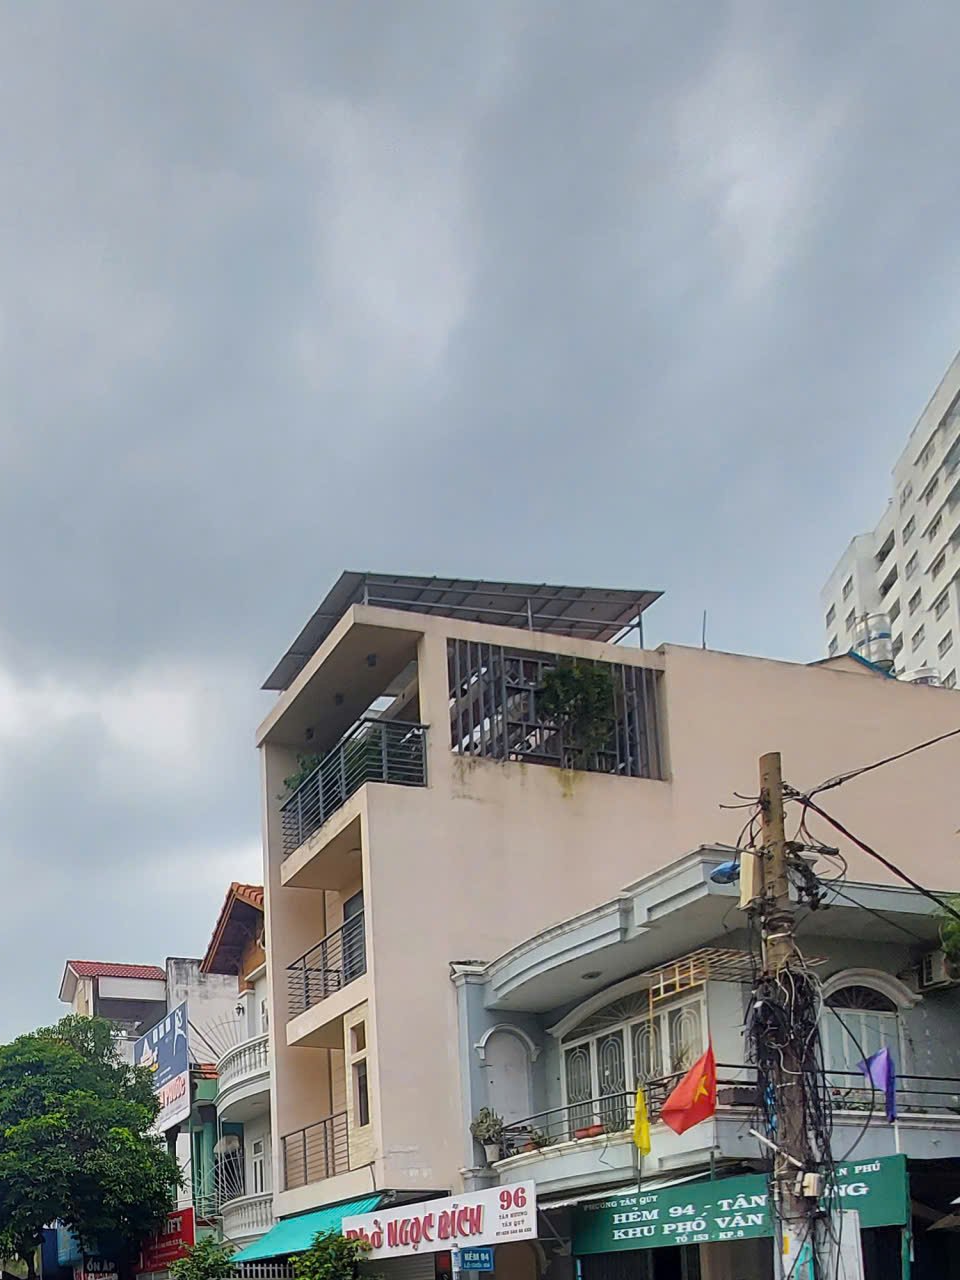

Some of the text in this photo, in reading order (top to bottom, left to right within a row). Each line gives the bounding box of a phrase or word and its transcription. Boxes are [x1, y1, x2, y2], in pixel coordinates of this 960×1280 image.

[854, 1160, 881, 1174] PHÚ
[499, 1186, 527, 1211] 96
[612, 1206, 660, 1225] HẺM
[669, 1204, 696, 1217] 94
[717, 1193, 768, 1212] TÂN
[386, 1212, 436, 1251] NGỌC
[612, 1212, 765, 1240] KHU PHỐ VĂN
